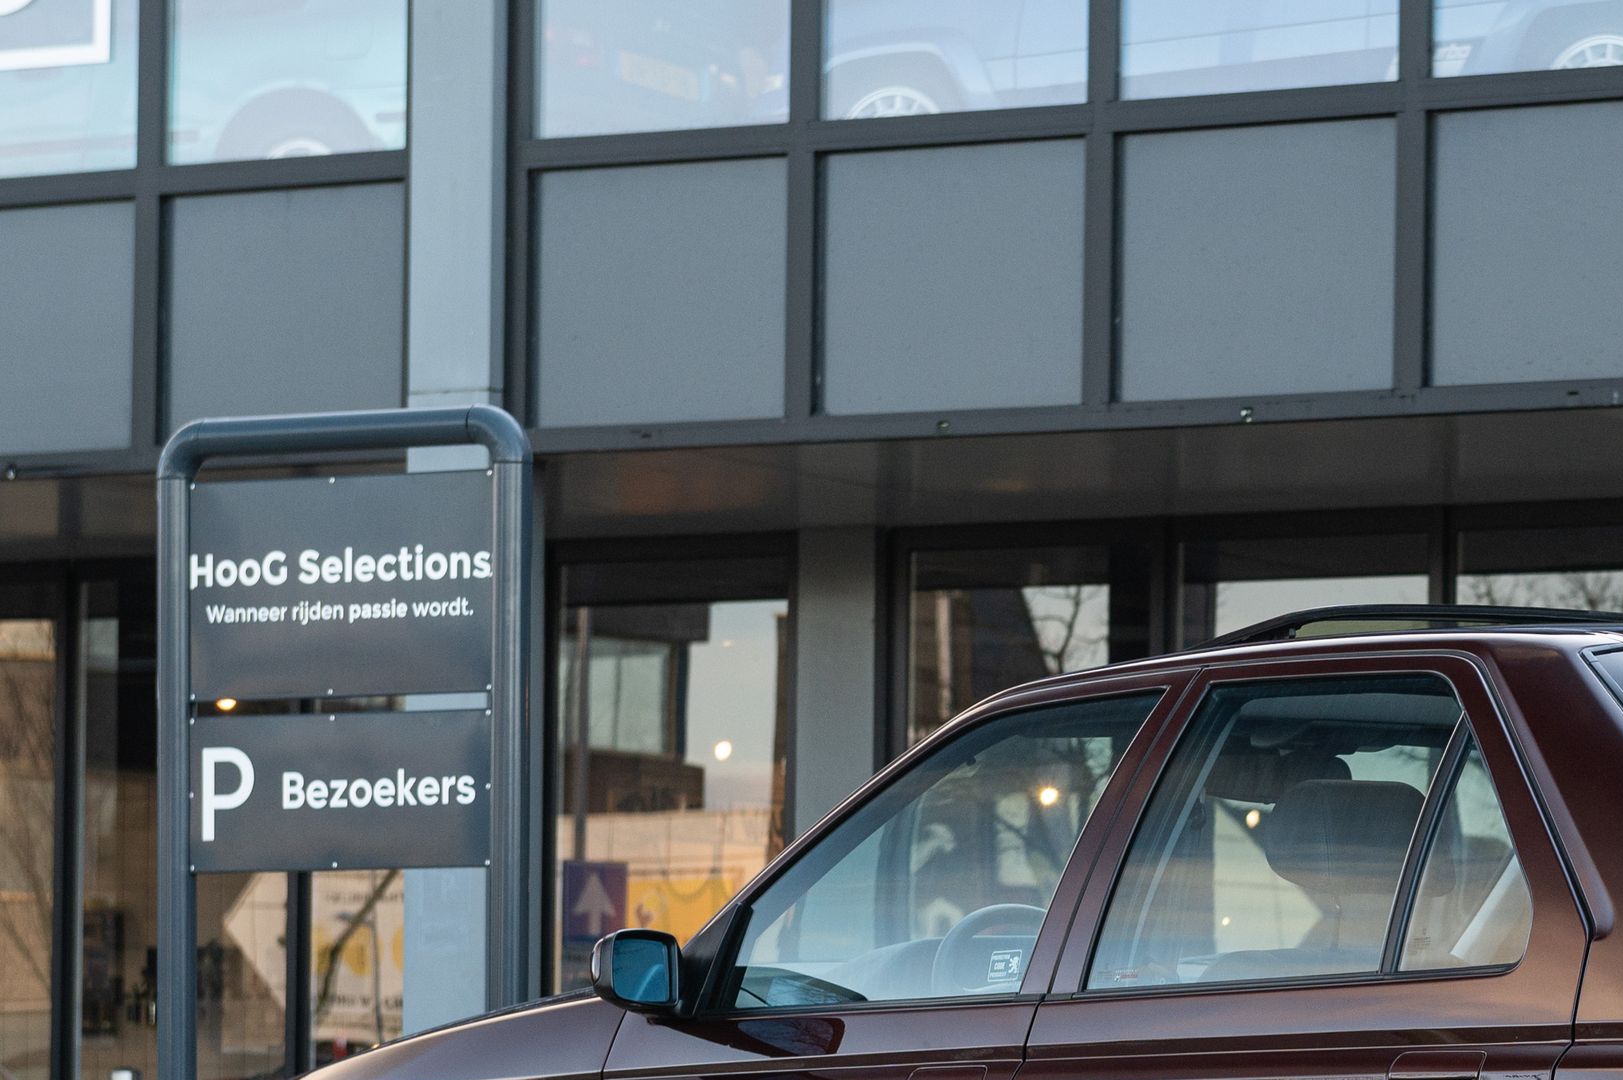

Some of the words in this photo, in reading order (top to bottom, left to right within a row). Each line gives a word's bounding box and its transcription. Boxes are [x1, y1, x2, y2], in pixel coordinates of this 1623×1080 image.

[190, 550, 288, 590] HooG
[298, 544, 492, 584] Selections
[205, 603, 288, 625] Wanneer
[291, 599, 344, 626] rijden
[348, 597, 408, 624] passie
[412, 596, 474, 618] wordt.
[201, 746, 256, 842] P
[281, 768, 477, 810] Bezoekers
